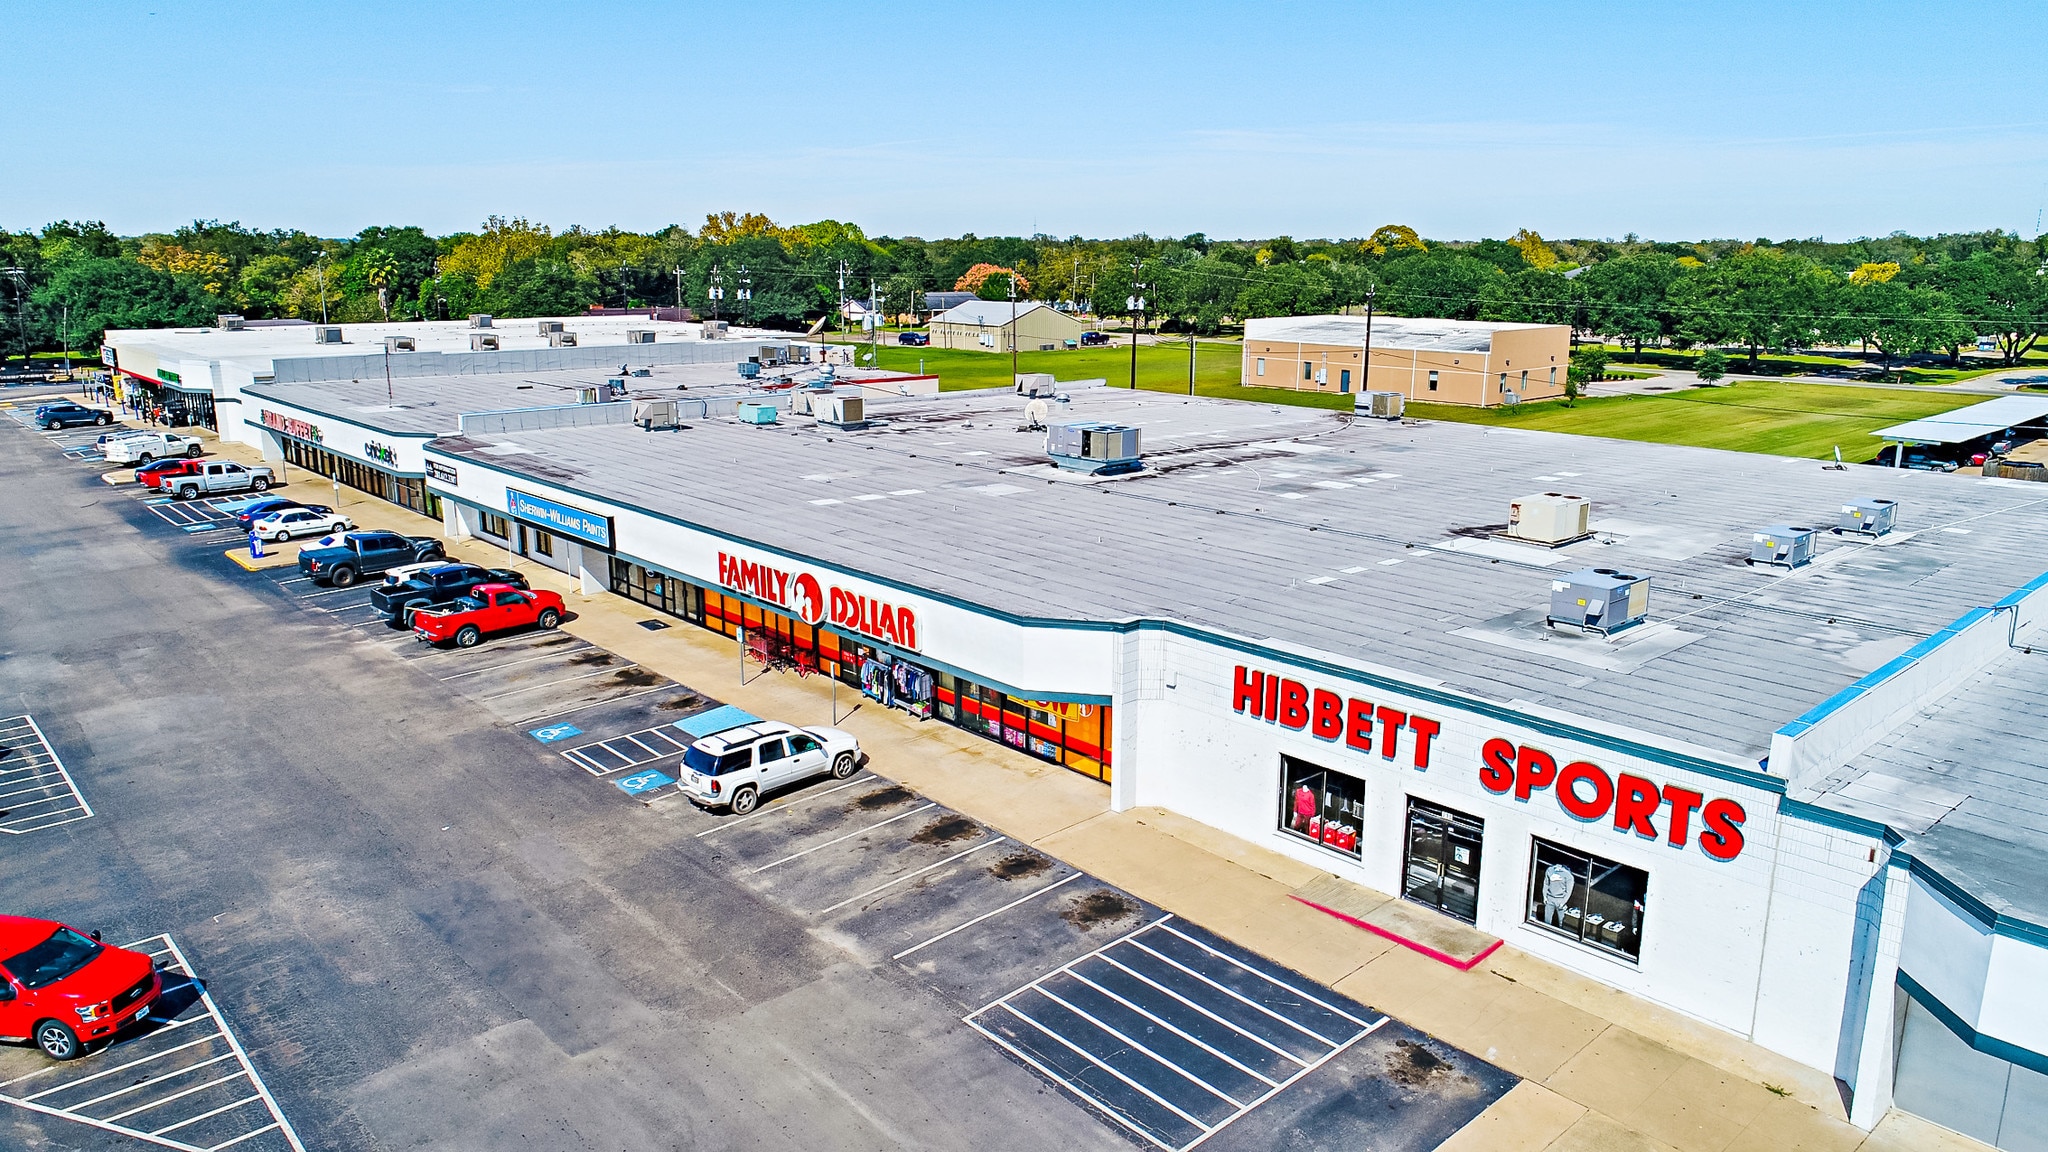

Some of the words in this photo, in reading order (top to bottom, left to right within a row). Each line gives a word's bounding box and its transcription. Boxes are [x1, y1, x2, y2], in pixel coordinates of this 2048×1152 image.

[718, 551, 790, 605] FAMILY
[829, 586, 917, 649] DOLLAR
[1233, 665, 1441, 772] HIBBETT
[1479, 738, 1747, 863] SPORTS
